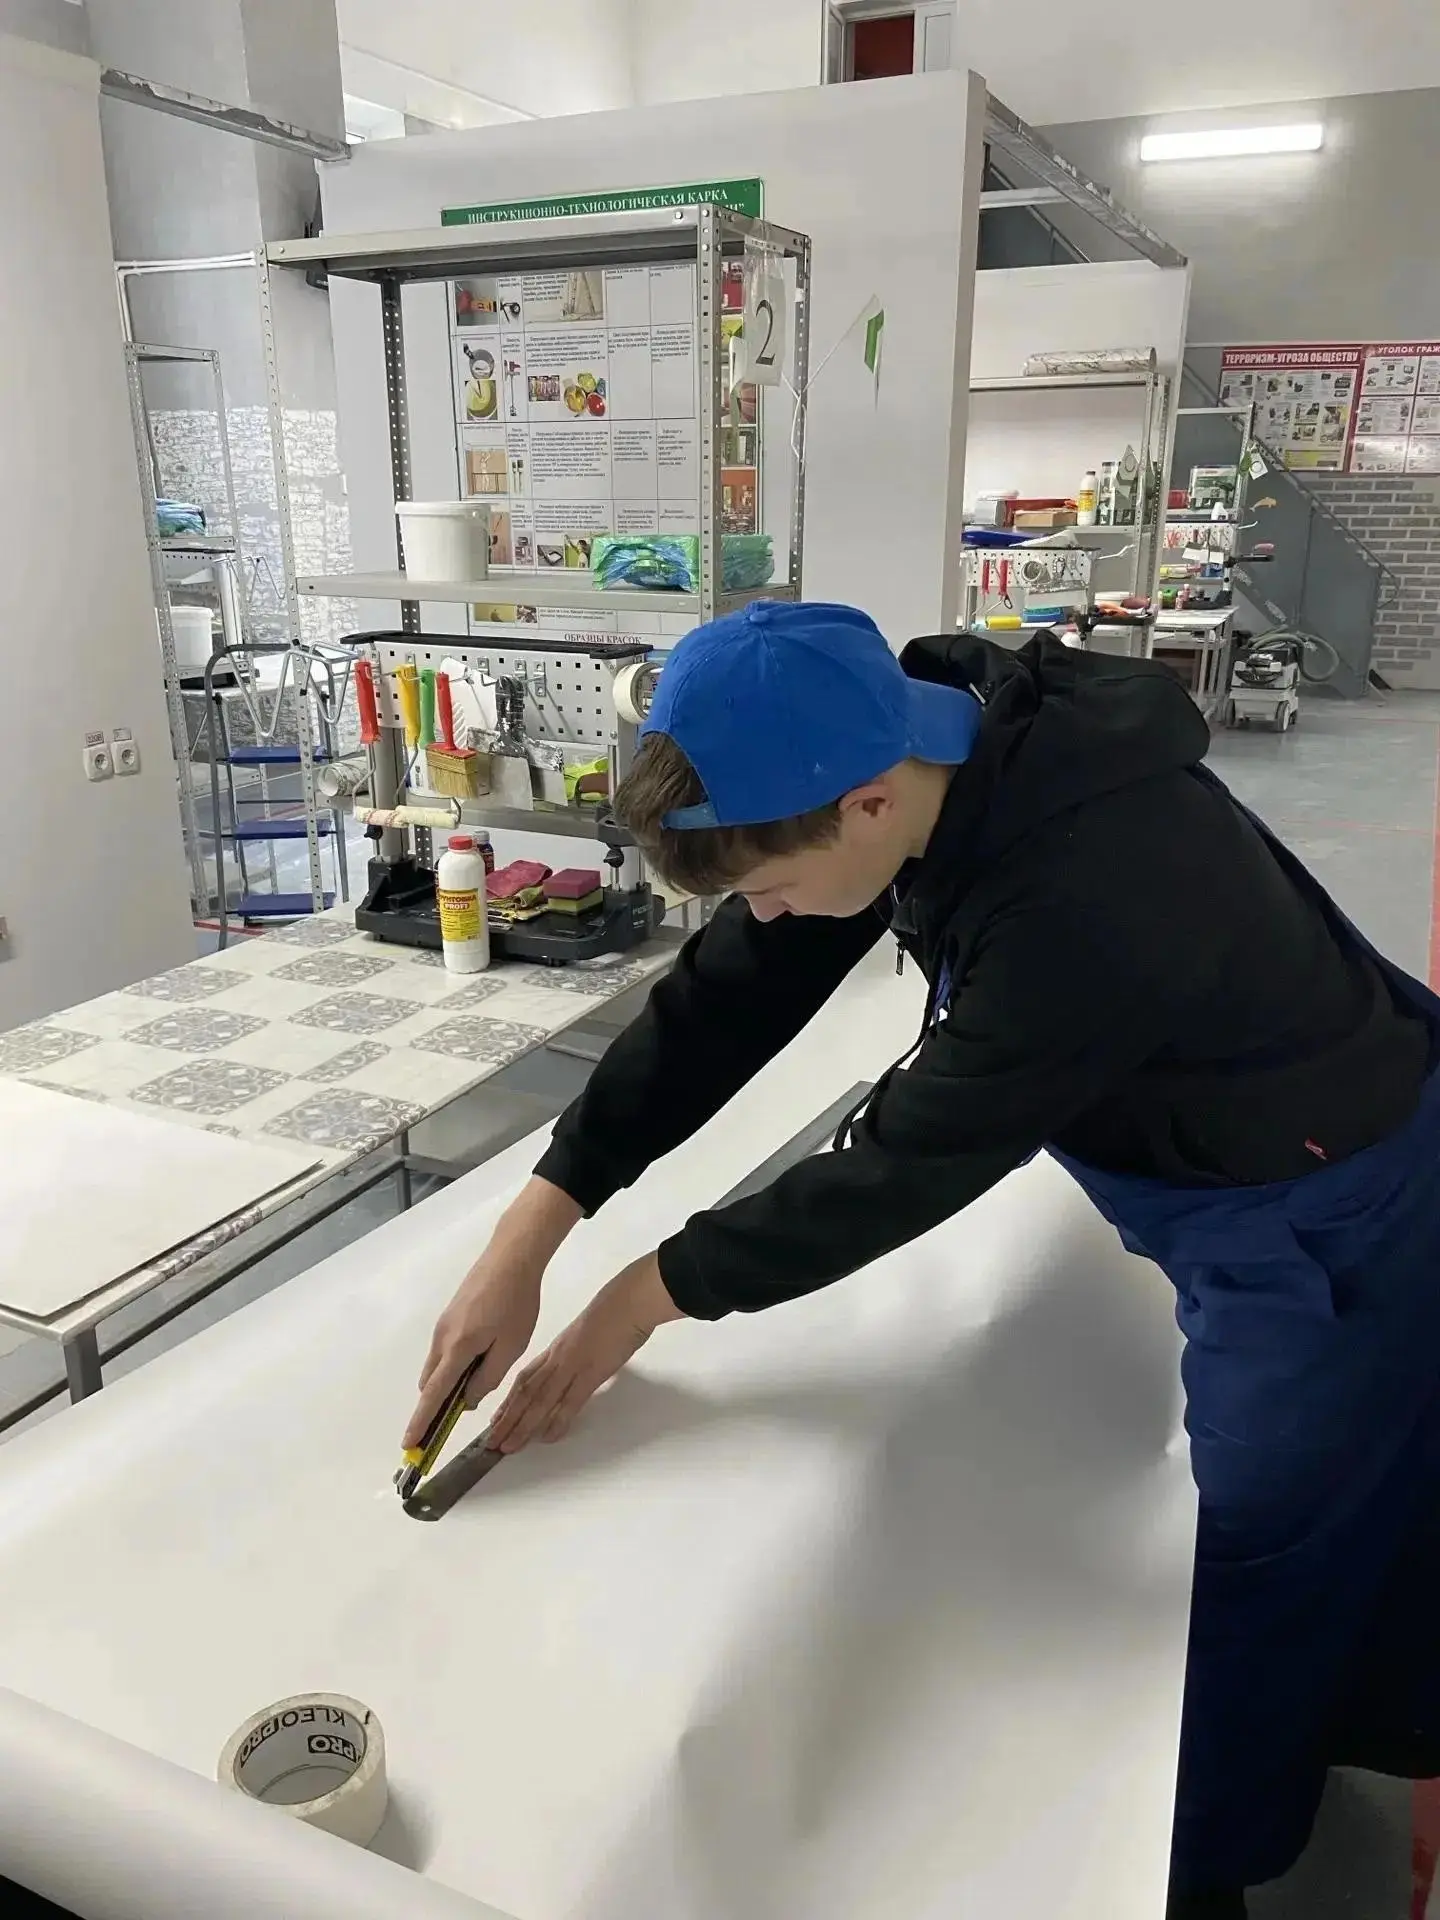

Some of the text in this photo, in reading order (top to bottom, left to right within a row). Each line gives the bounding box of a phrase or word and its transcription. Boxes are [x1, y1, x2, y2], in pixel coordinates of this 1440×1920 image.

[688, 189, 728, 203] КАРКА
[755, 299, 776, 366] 2
[1378, 346, 1414, 354] УГОЛОК
[1225, 351, 1359, 364] ТЕРРОРИЗМ-УГРОЗА ОБЩЕСТВУ
[564, 633, 642, 644] ОБРАЗЦЫ КРАСОК
[282, 1707, 346, 1728] KLEO
[309, 1735, 356, 1762] PRO
